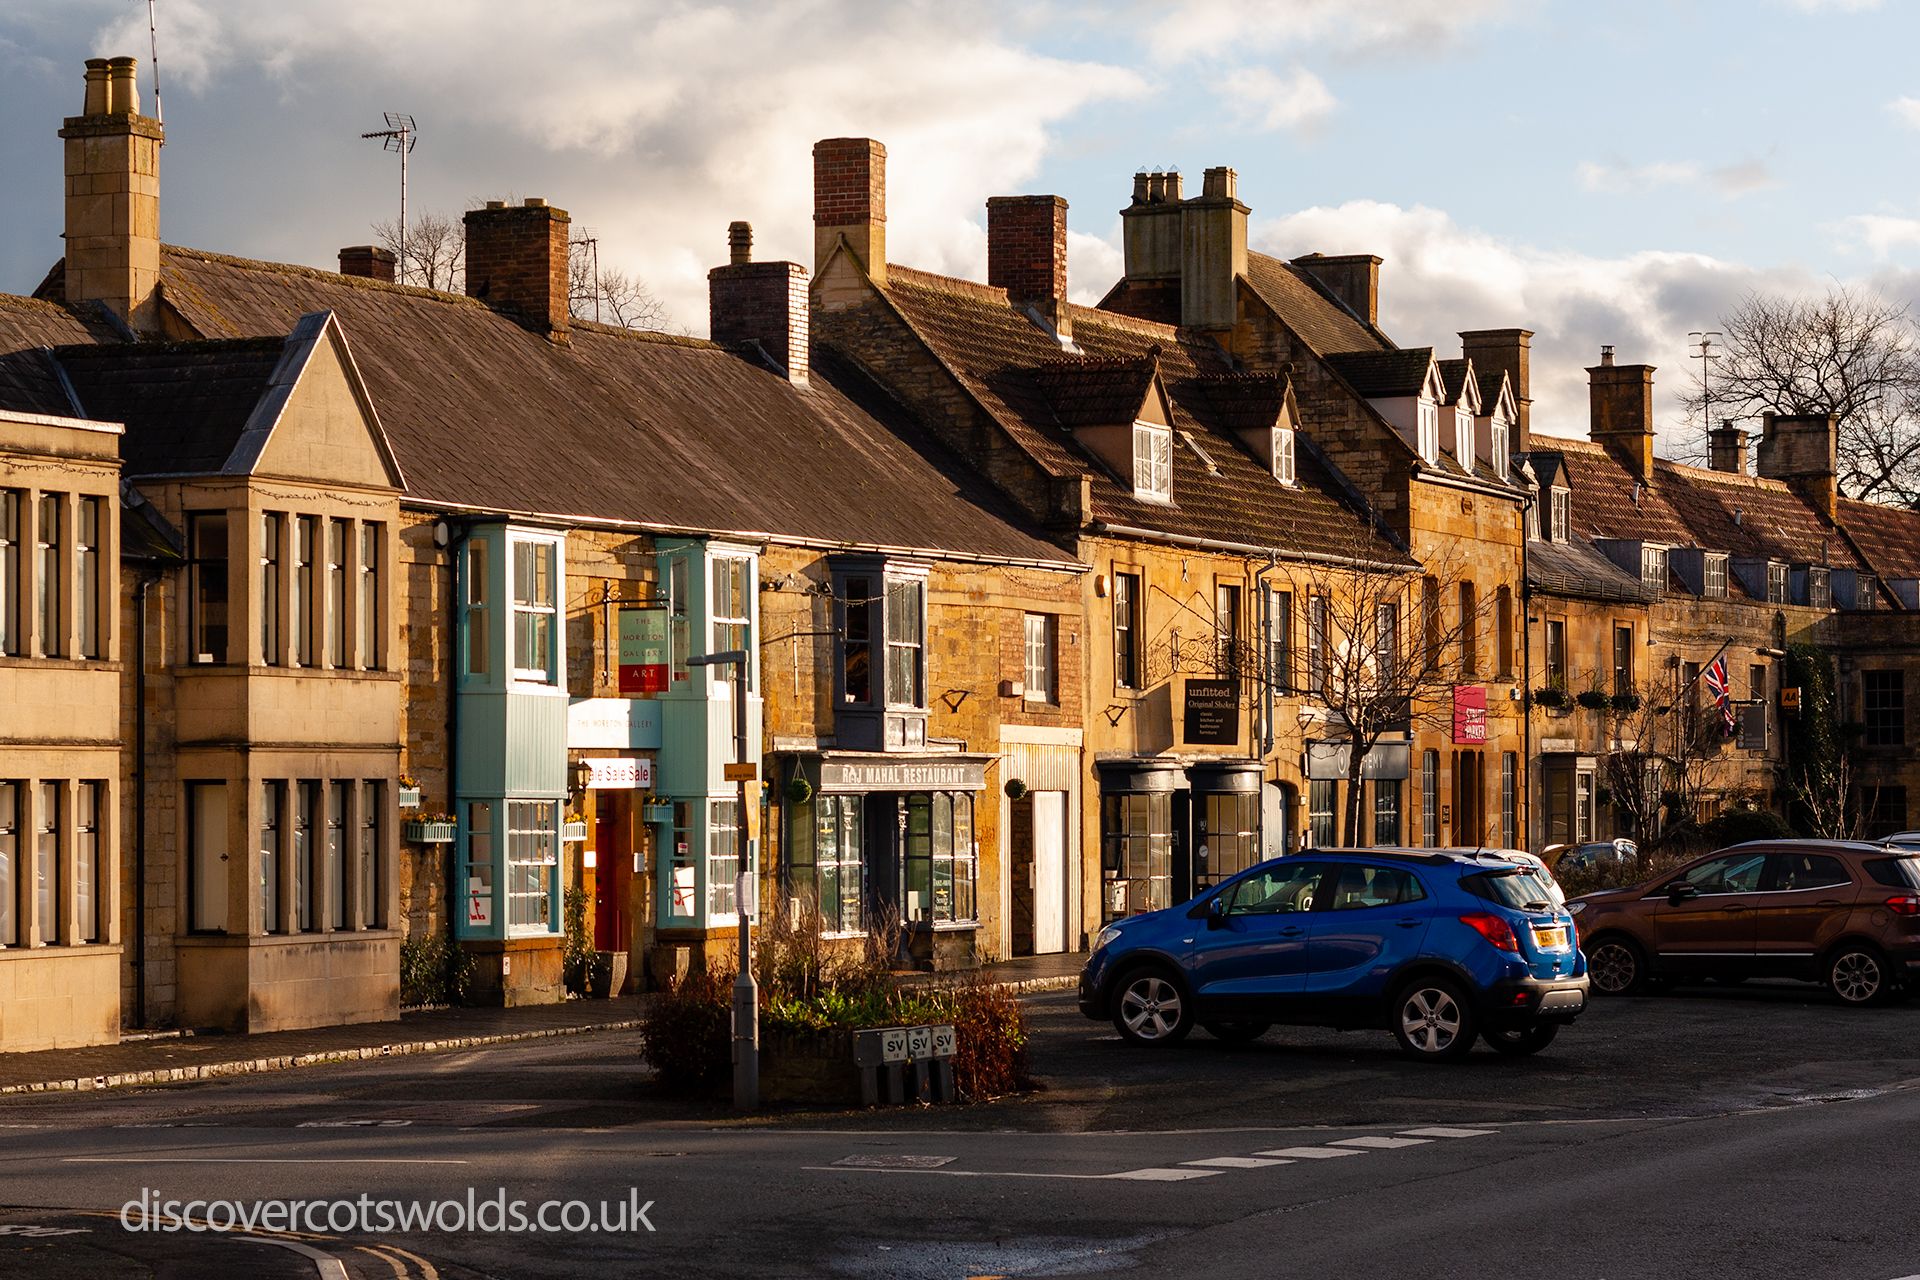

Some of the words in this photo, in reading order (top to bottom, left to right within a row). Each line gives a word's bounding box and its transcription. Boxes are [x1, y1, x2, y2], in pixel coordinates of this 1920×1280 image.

[633, 669, 655, 678] ART
[1189, 687, 1231, 697] unfitted
[1784, 692, 1797, 702] AA
[1188, 700, 1214, 709] Original
[626, 720, 653, 728] GALLERY
[589, 766, 603, 781] ale
[605, 765, 626, 781] Sale
[628, 765, 649, 781] Sale
[842, 767, 862, 783] RAJ
[866, 767, 900, 783] MAHAL
[903, 767, 965, 783] RESTAURANT
[887, 1039, 904, 1052] SV
[912, 1037, 928, 1050] SV
[936, 1034, 952, 1047] SV
